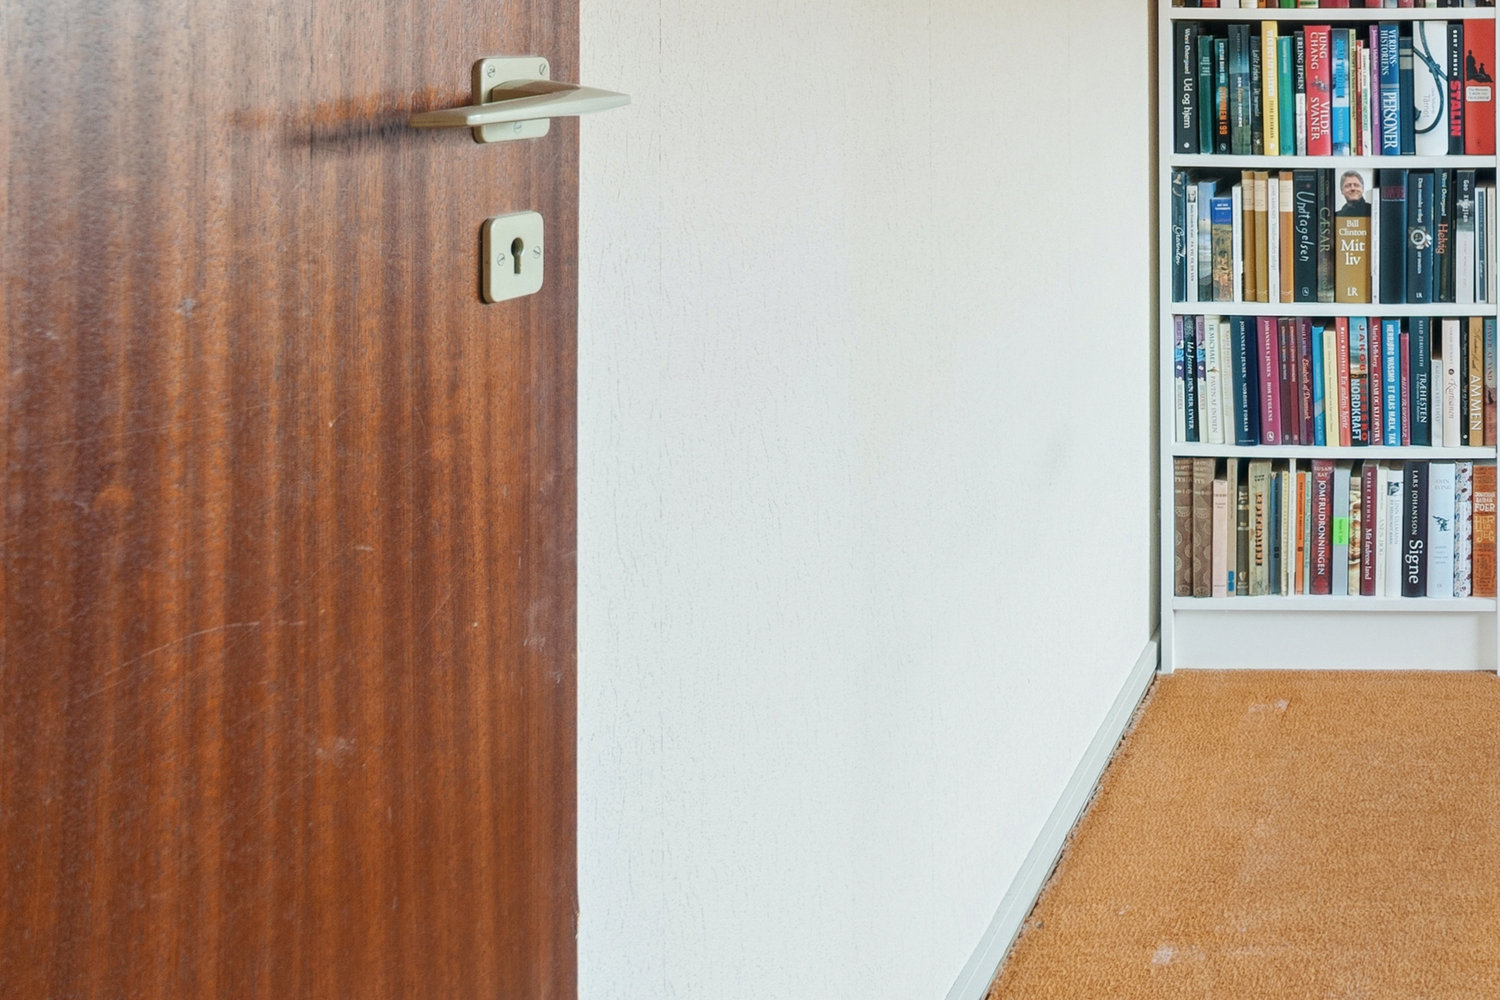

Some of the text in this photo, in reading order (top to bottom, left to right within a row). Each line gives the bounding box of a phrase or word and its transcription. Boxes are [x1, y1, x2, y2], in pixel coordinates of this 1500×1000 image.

[1318, 32, 1327, 58] JUNG
[1389, 30, 1397, 67] VERDENS-
[1182, 78, 1192, 128] Ud og hjem
[1311, 97, 1319, 140] SVANER
[1320, 101, 1329, 135] VILDE
[1383, 92, 1397, 148] PERSONER
[1450, 80, 1461, 136] STALIN
[1296, 191, 1315, 262] Undtagelsen
[1320, 207, 1330, 252] CÆSAR
[1339, 228, 1367, 236] Clinton
[1340, 239, 1366, 251] Mit
[1345, 252, 1361, 265] liv
[1347, 287, 1358, 296] LR
[1386, 324, 1394, 356] HERBJØRG
[1387, 357, 1395, 382] WASSMO
[1388, 385, 1395, 393] ET
[1471, 375, 1481, 431] AMMEN
[1351, 378, 1361, 440] NORDKRAFT
[1388, 433, 1396, 444] TAK
[1318, 480, 1326, 575] JOMFRUDRONNINGEN
[1405, 540, 1423, 584] Signe
